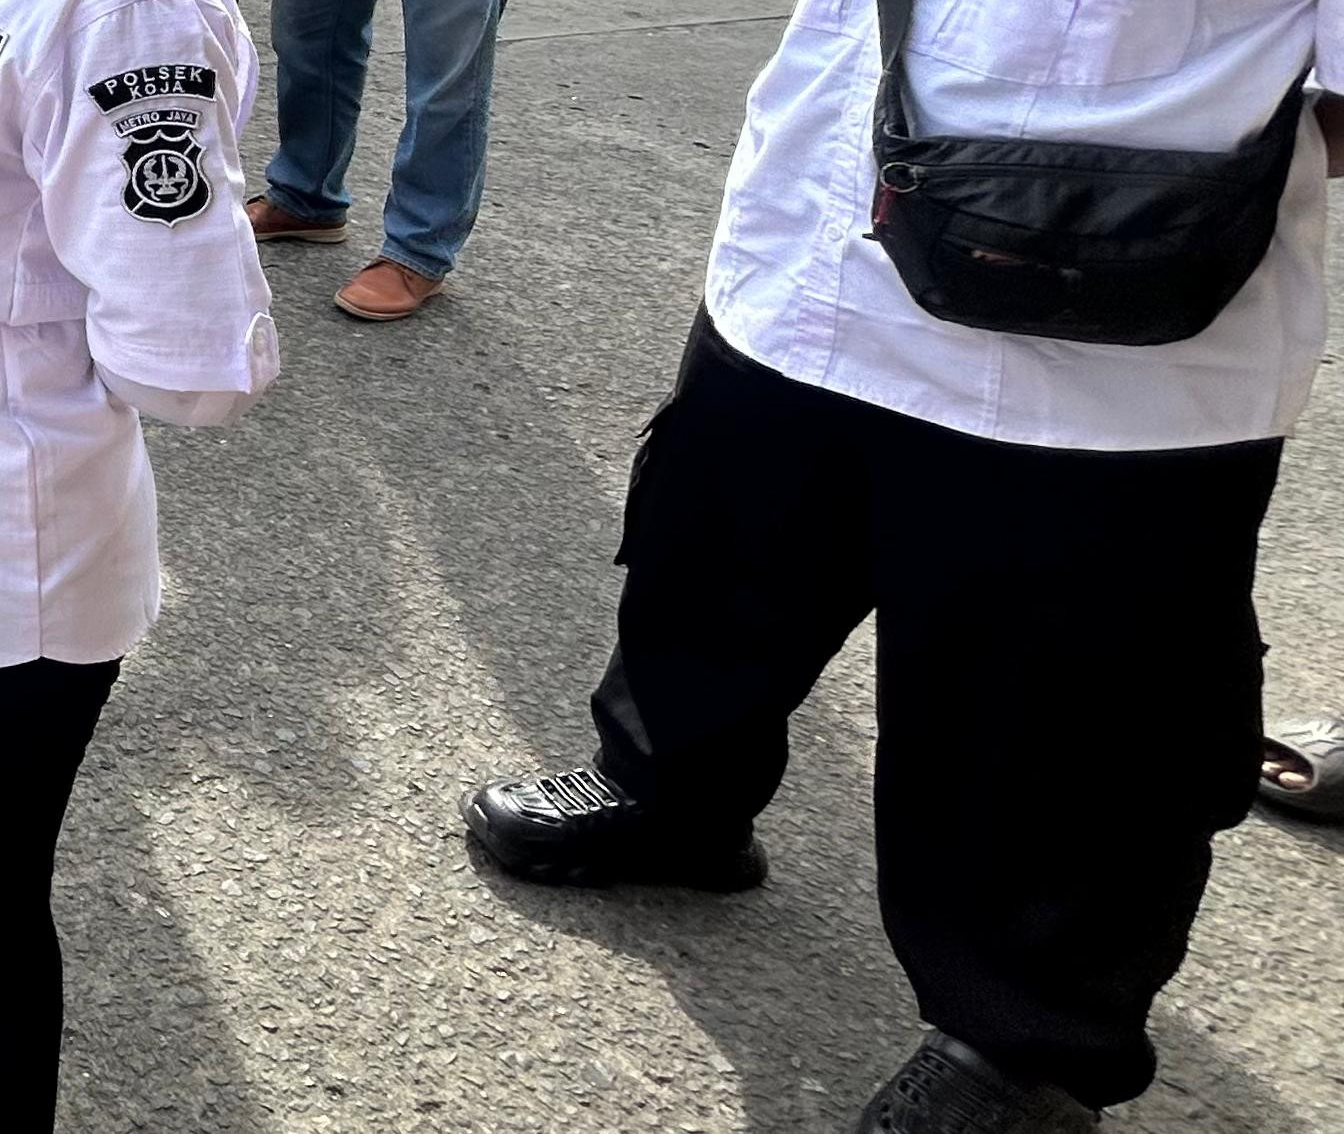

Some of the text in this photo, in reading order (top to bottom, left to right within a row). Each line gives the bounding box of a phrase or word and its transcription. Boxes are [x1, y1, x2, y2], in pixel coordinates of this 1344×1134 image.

[104, 66, 204, 95] POLSEK
[129, 80, 186, 100] KOJA
[119, 111, 195, 132] METRO JAYA
